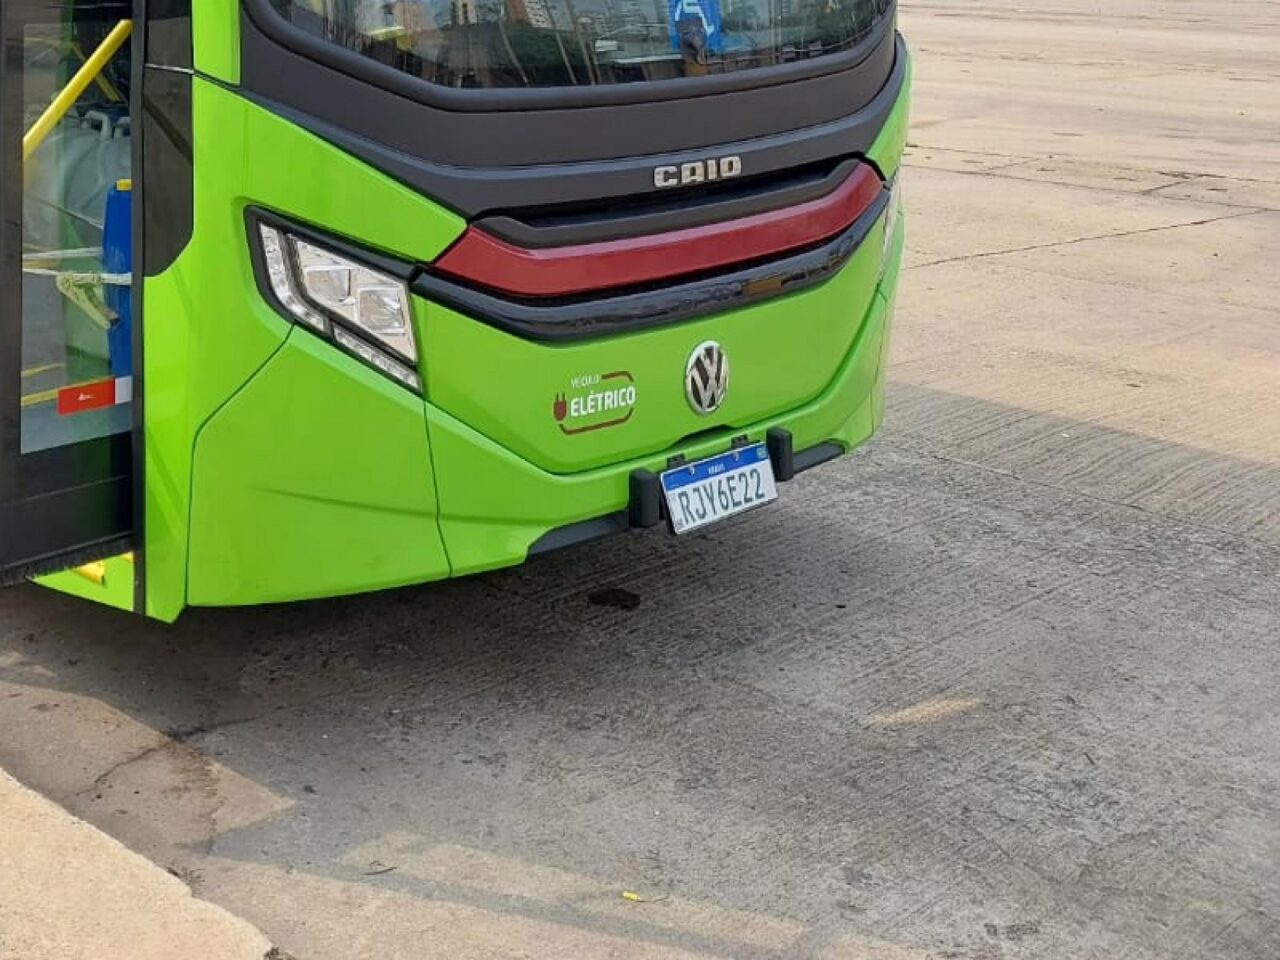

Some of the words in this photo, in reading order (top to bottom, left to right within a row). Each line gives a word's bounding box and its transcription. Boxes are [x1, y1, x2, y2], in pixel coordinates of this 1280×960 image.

[653, 155, 742, 188] CAIO
[570, 386, 636, 417] ELÉTRICO
[677, 468, 766, 526] RJY6E22
